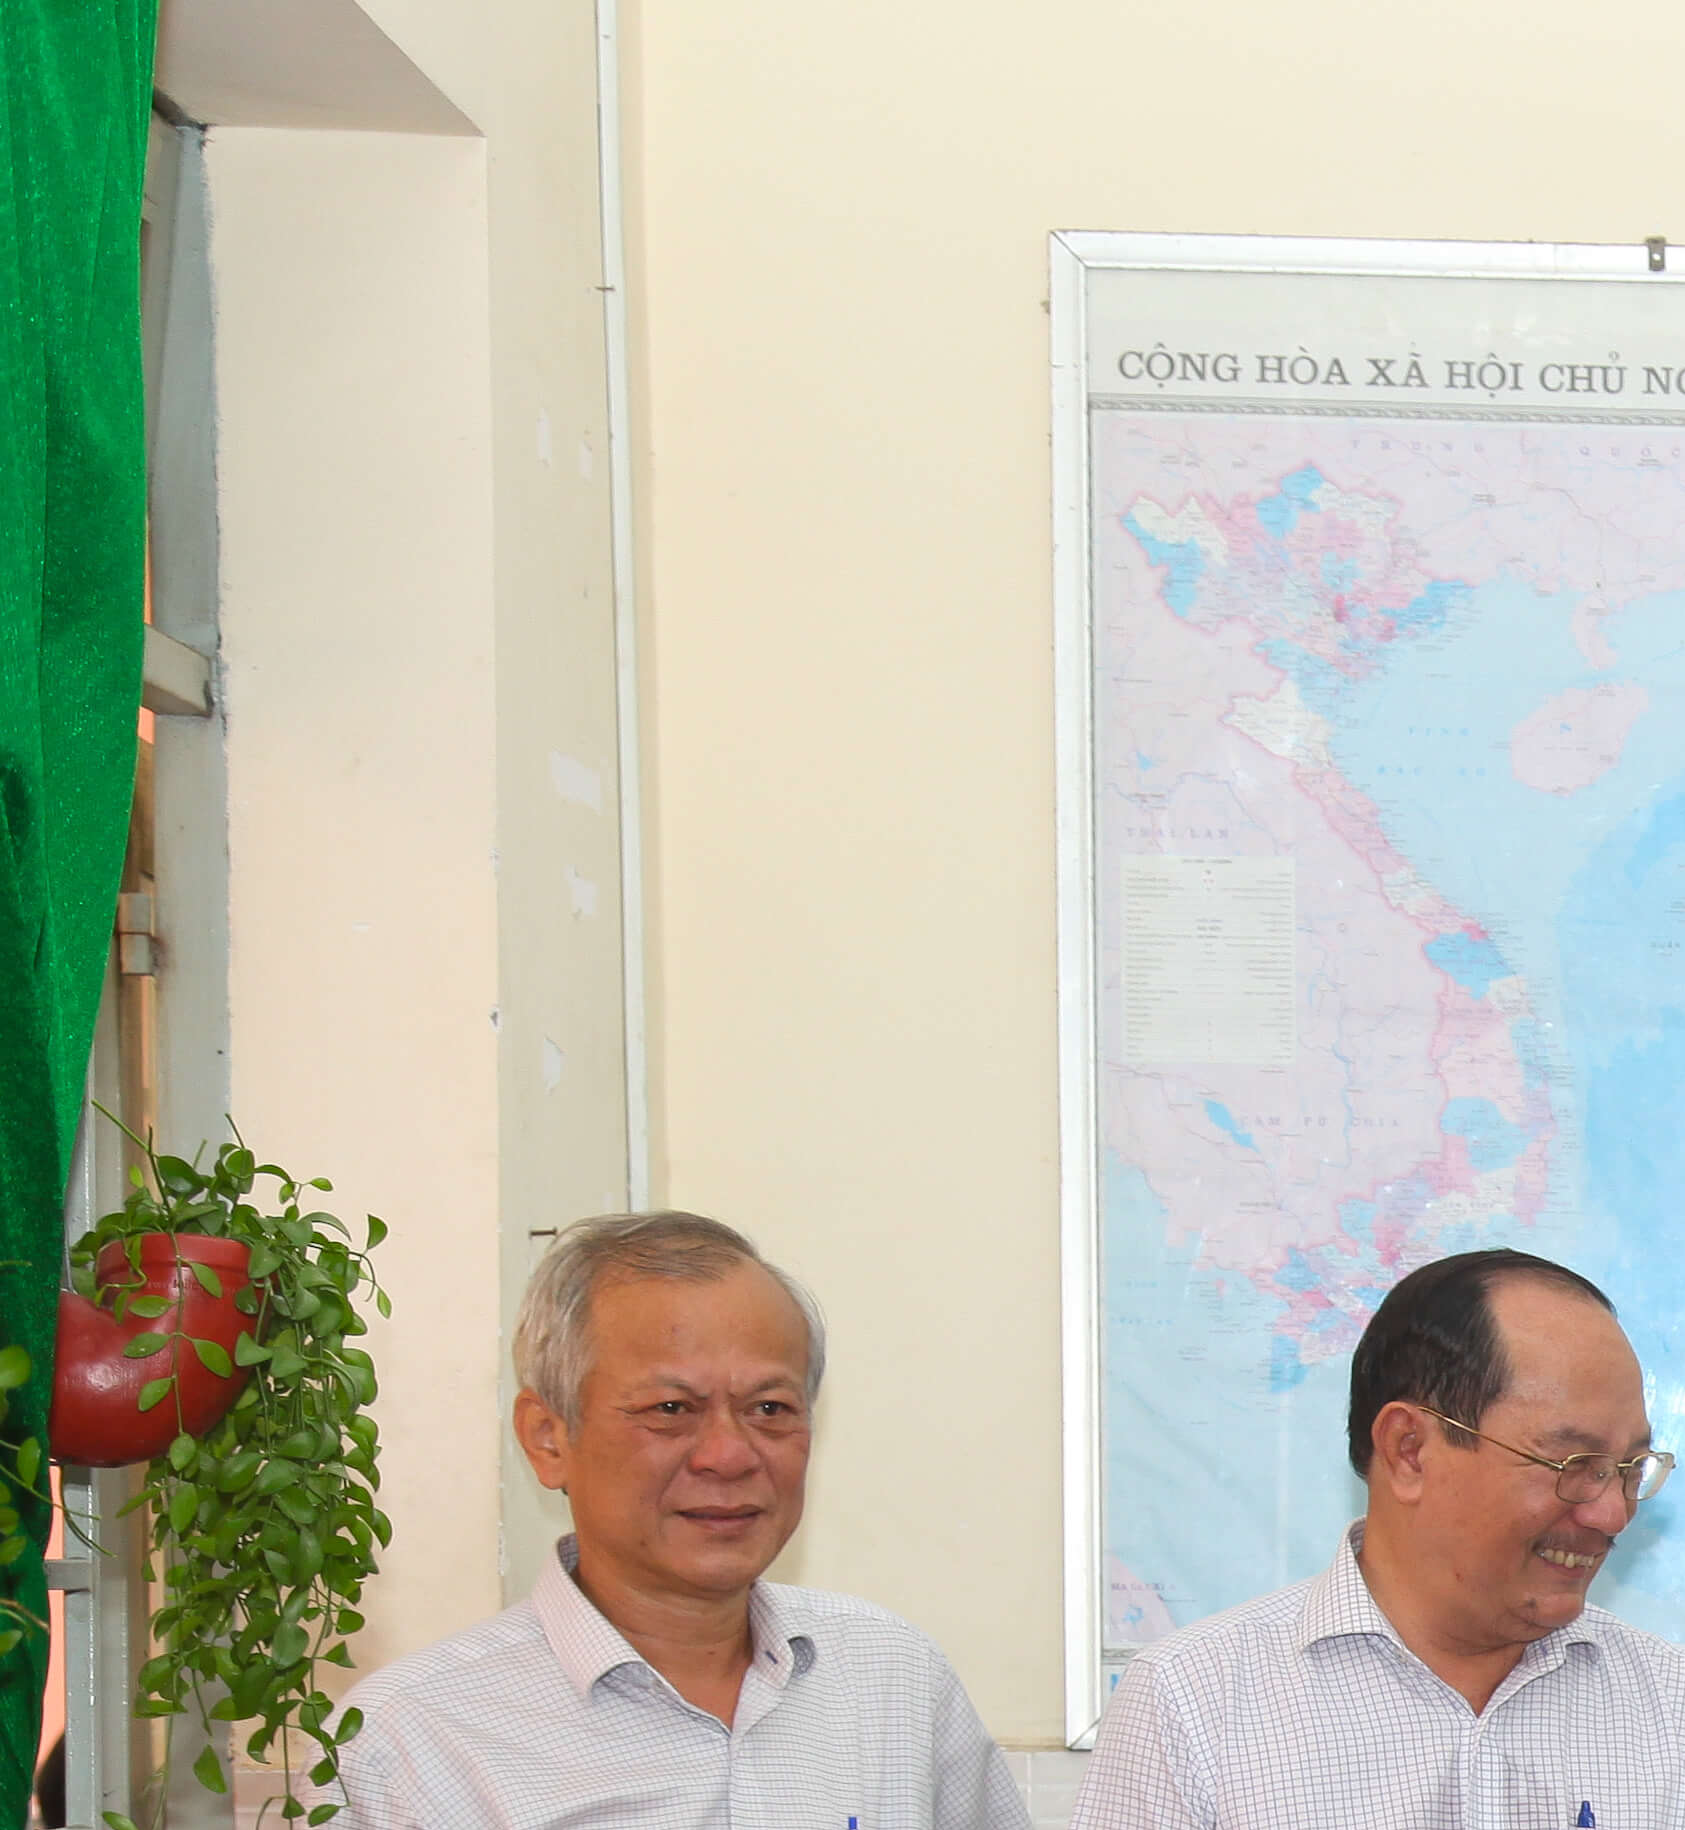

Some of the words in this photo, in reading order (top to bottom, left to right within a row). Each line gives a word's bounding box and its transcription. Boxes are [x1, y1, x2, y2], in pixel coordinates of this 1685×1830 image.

[1117, 342, 1244, 389] CỘNG
[1255, 345, 1350, 386] HÒA
[1365, 350, 1430, 389] XÃ
[1444, 351, 1525, 399] HỘI
[1539, 350, 1627, 395] CHỦ
